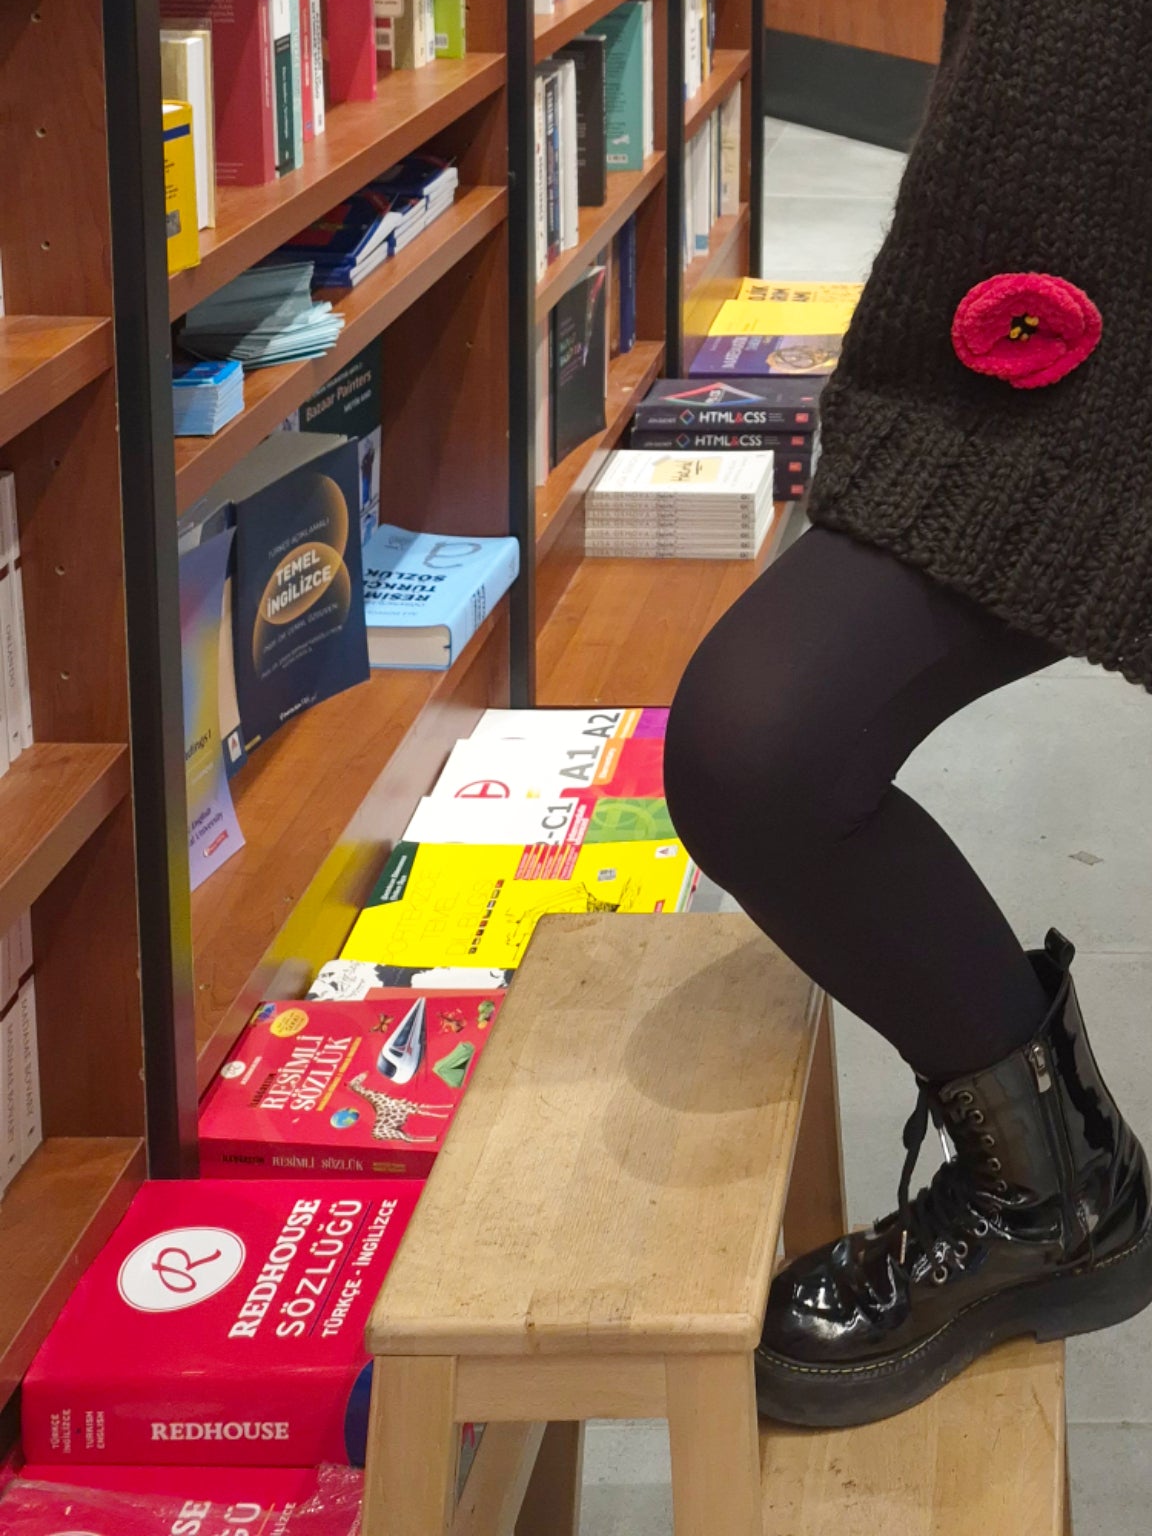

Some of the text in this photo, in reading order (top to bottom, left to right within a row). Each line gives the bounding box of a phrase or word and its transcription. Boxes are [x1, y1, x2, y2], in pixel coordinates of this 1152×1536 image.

[275, 549, 320, 586] TEMEL
[266, 565, 332, 618] İNGİLİZCE
[364, 591, 431, 602] RESİM
[582, 712, 621, 739] A2
[558, 745, 601, 781] A1
[260, 1035, 324, 1110] RESİMLİ
[289, 1036, 352, 1112] SÖZLÜK
[272, 1155, 315, 1168] RESİMLİ
[321, 1158, 364, 1171] SÖZLÜK
[228, 1198, 321, 1338] REDHOUSE
[275, 1200, 363, 1338] SÖZLÜĞÜ
[321, 1278, 363, 1338] TÜRKÇE
[357, 1199, 398, 1267] İNGİLİZCE
[51, 1414, 60, 1449] TÜRKÇE
[62, 1409, 72, 1454] İNGİLİZCE
[86, 1411, 94, 1449] TURKISH
[96, 1411, 105, 1449] ENGLISH
[151, 1421, 289, 1441] REDHOUSE
